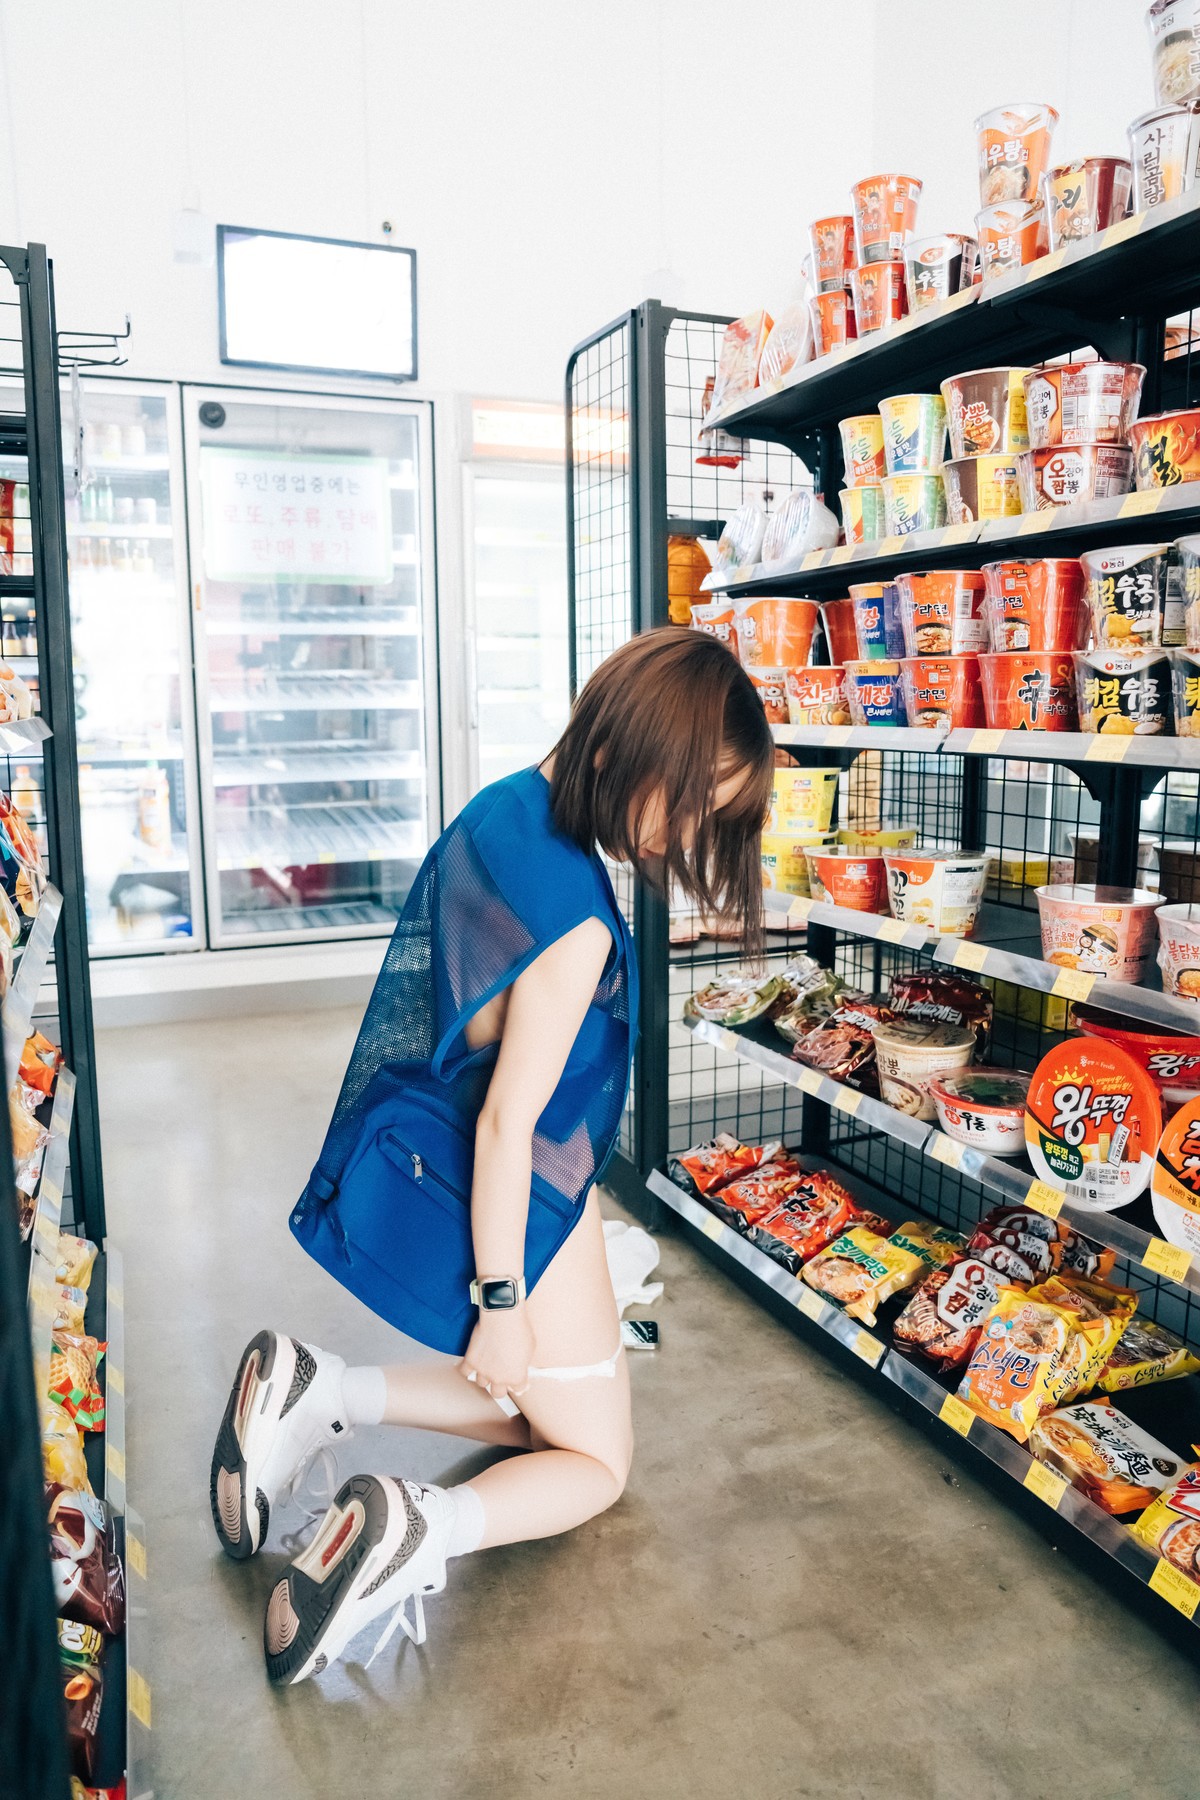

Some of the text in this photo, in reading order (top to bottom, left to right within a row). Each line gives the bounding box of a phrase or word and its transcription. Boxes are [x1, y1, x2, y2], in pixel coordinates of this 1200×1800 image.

[1142, 127, 1166, 208] 사리곰탕
[1048, 458, 1084, 479] 오징어
[235, 471, 362, 495] 무인영업중에는
[1051, 479, 1080, 495] 짬뽕
[335, 508, 378, 531] 담배
[309, 538, 351, 563] 불가
[1109, 560, 1125, 569] 농심
[1017, 668, 1059, 724] 辛
[1043, 704, 1069, 717] 라면
[959, 1111, 987, 1132] 우동
[1051, 1084, 1132, 1146] 왕뚜껑
[1045, 1141, 1080, 1165] 왕뚜껑 먹고
[1115, 1130, 1128, 1159] TRAVEL
[1050, 1156, 1079, 1176] 놀러가자!
[831, 1236, 889, 1279] 참깨라면
[1163, 1265, 1184, 1280] 1,400
[944, 1290, 984, 1324] 짬뽕
[967, 1340, 1040, 1389] 스낵면
[1134, 1363, 1166, 1385] 스낵면
[1112, 1416, 1129, 1430] 농심
[1179, 1600, 1193, 1616] 950
